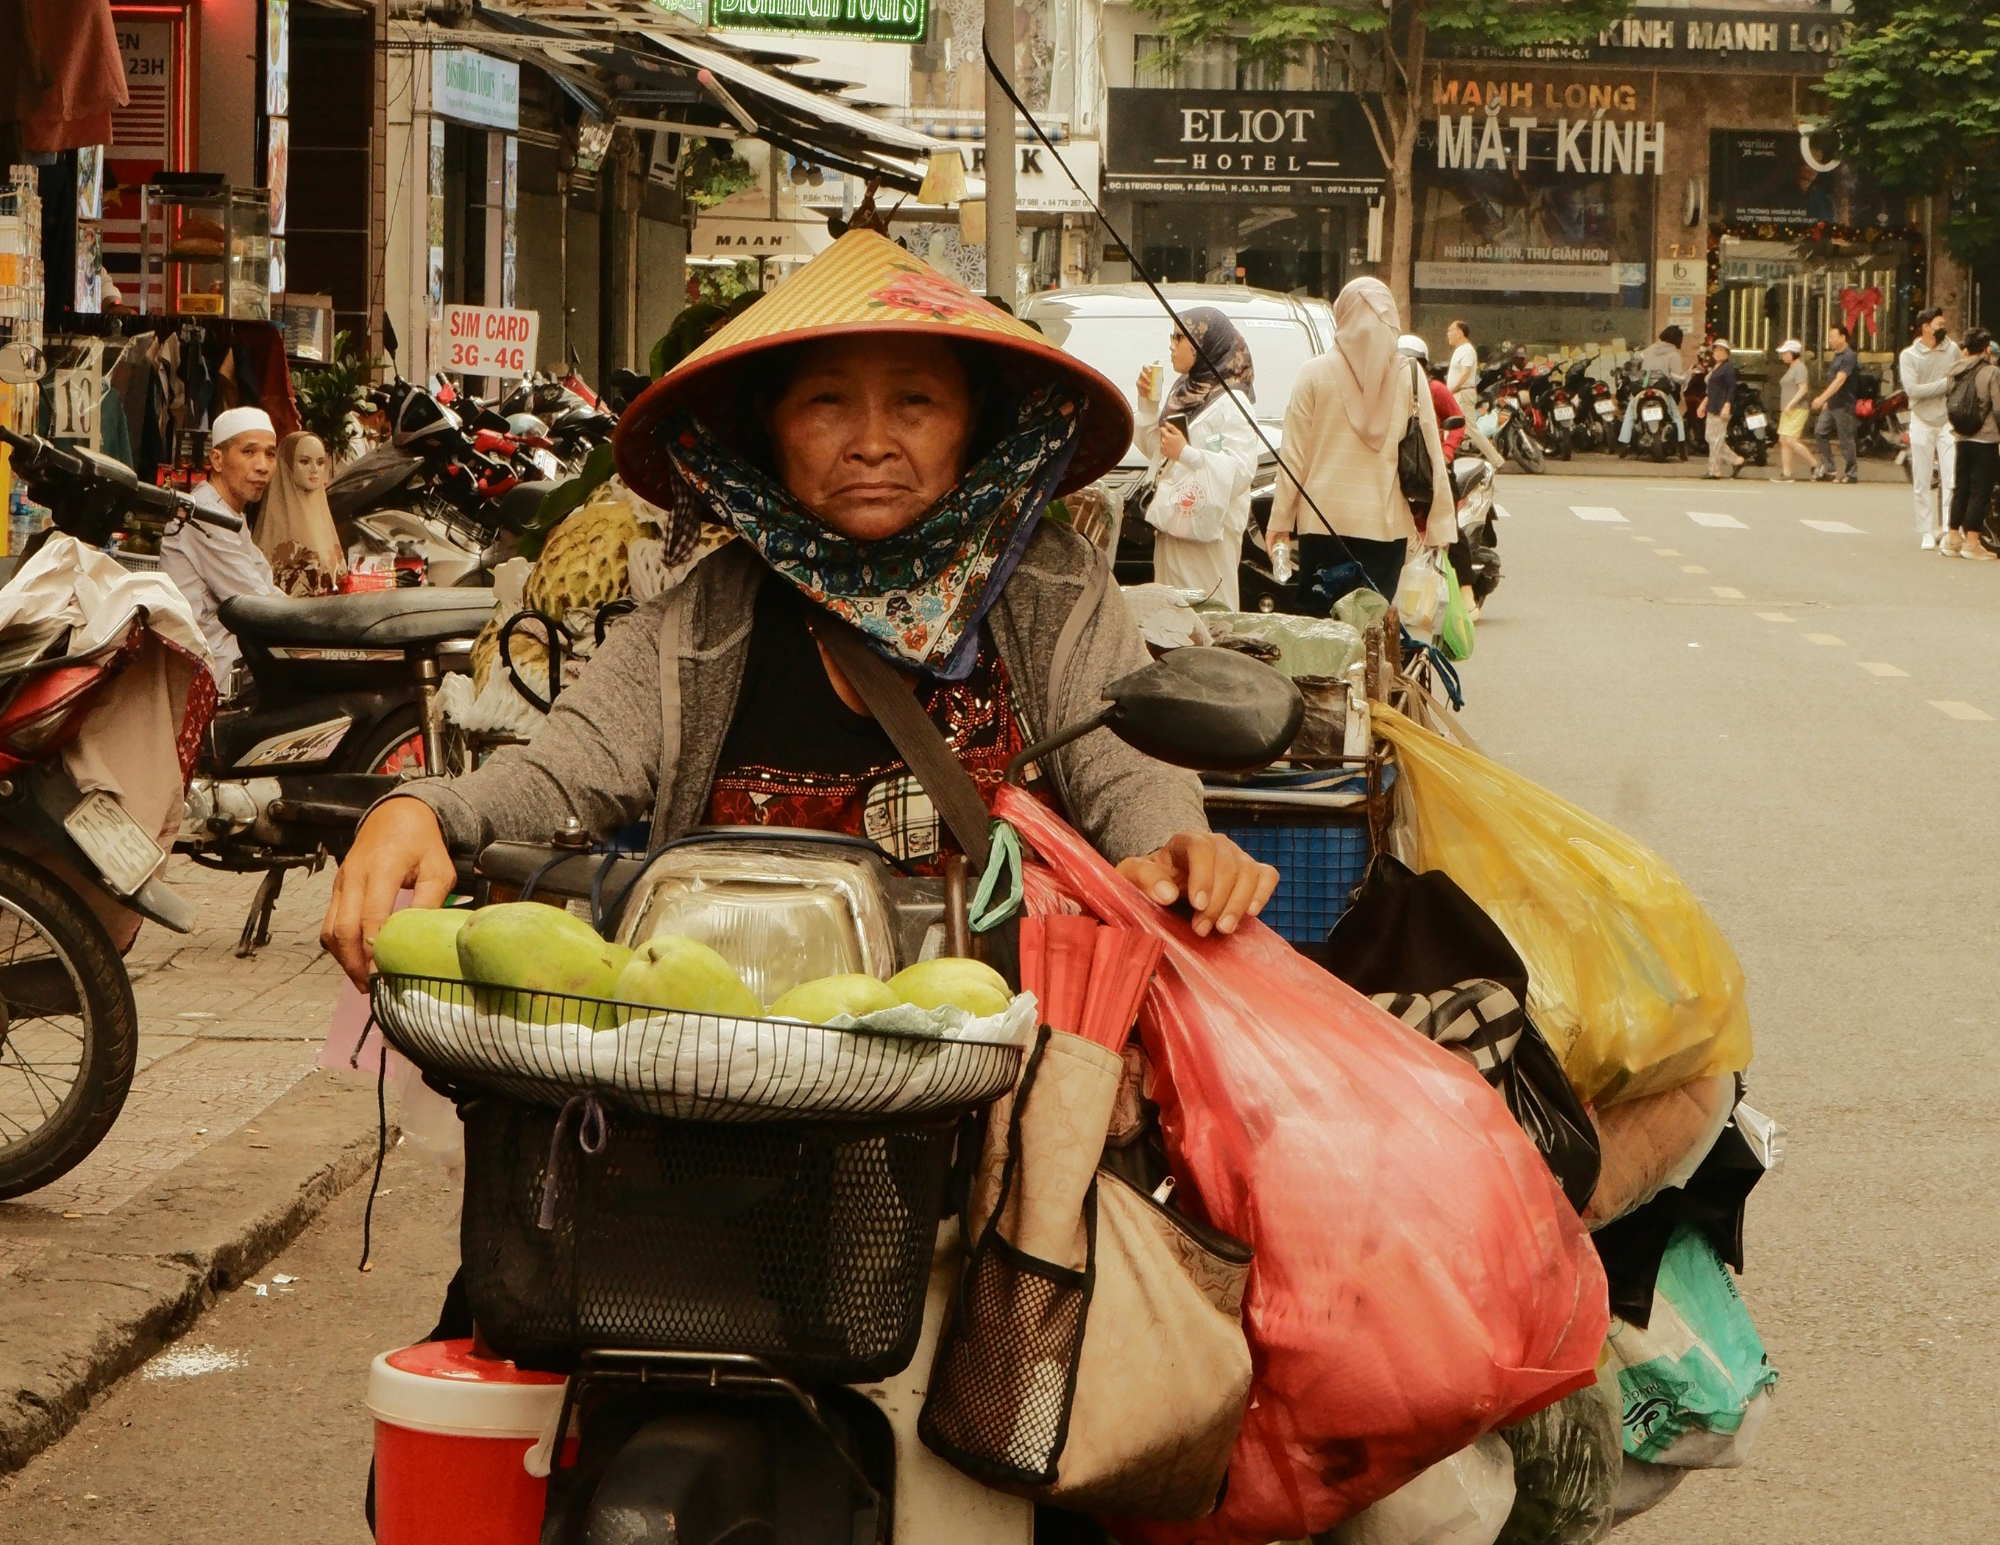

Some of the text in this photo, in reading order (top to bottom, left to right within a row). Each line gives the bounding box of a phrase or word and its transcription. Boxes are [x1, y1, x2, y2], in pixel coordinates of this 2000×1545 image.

[1688, 20, 1779, 58] MẠNH
[129, 58, 164, 76] 23H
[1546, 83, 1637, 111] LONG
[1180, 108, 1315, 143] ELIOT
[1437, 96, 1665, 175] MẮT KÍNH
[1192, 154, 1301, 172] HOTEL
[715, 235, 783, 247] MAAN
[450, 311, 529, 342] SIM CARD
[321, 650, 368, 660] HONDA
